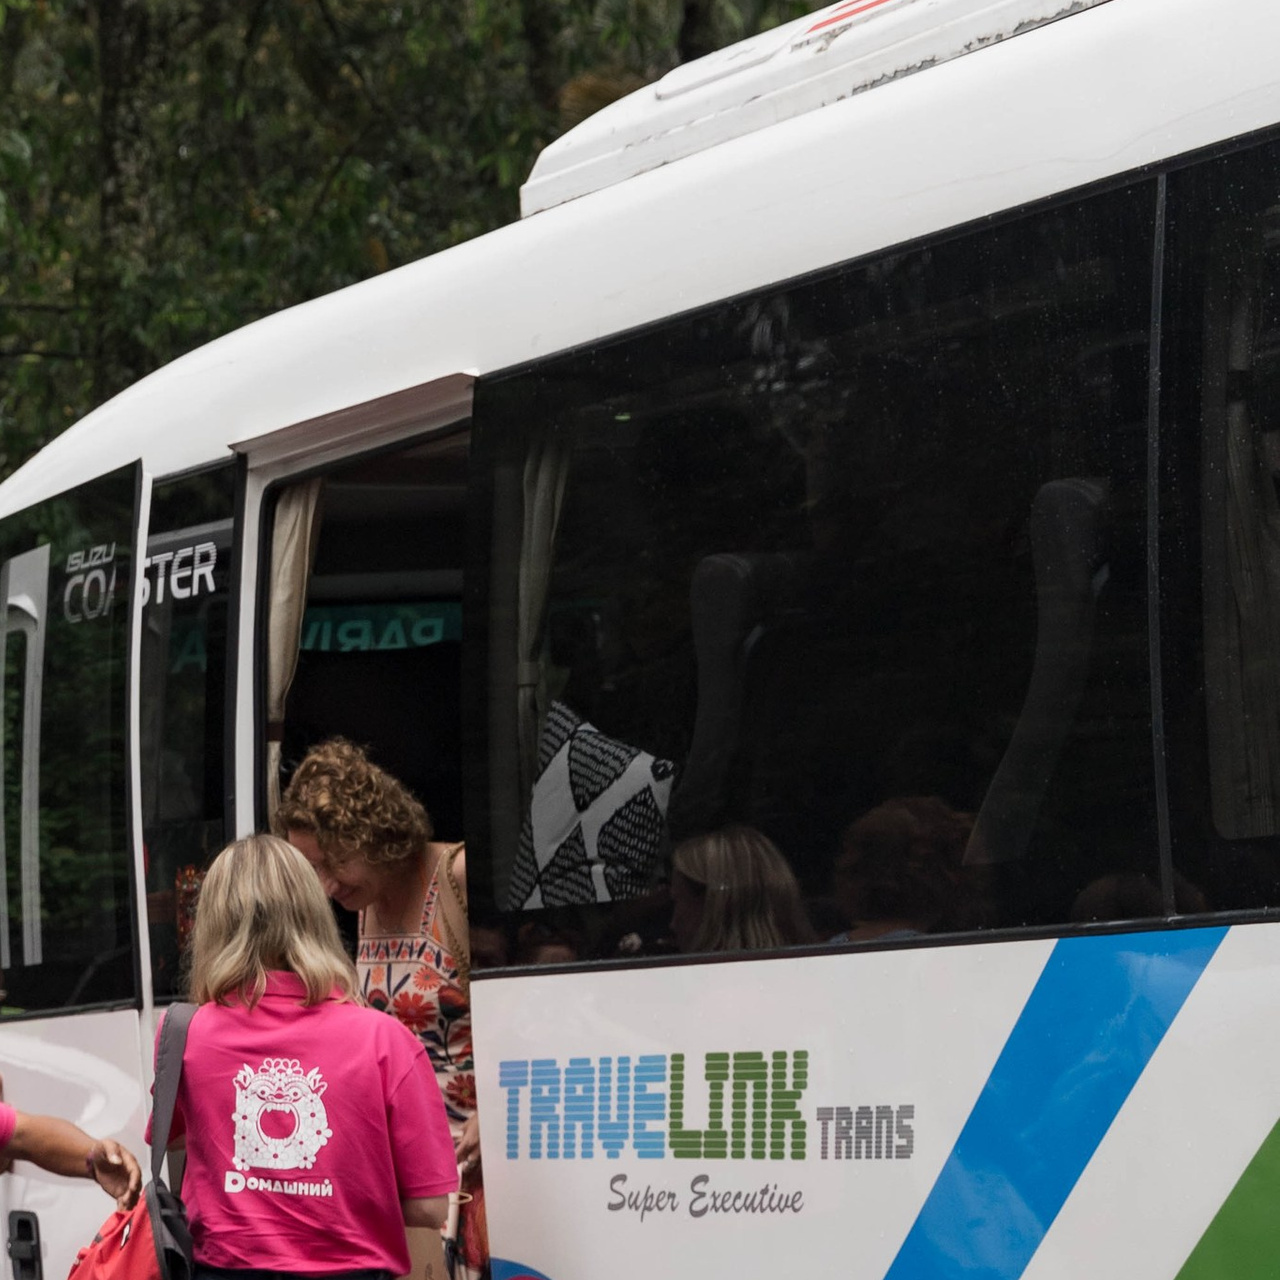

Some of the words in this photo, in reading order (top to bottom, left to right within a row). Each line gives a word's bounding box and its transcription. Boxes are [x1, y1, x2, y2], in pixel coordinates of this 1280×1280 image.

[65, 541, 116, 573] ISUZU
[817, 1105, 914, 1160] TRANS
[607, 1174, 679, 1222] Super
[689, 1174, 804, 1218] Executive
